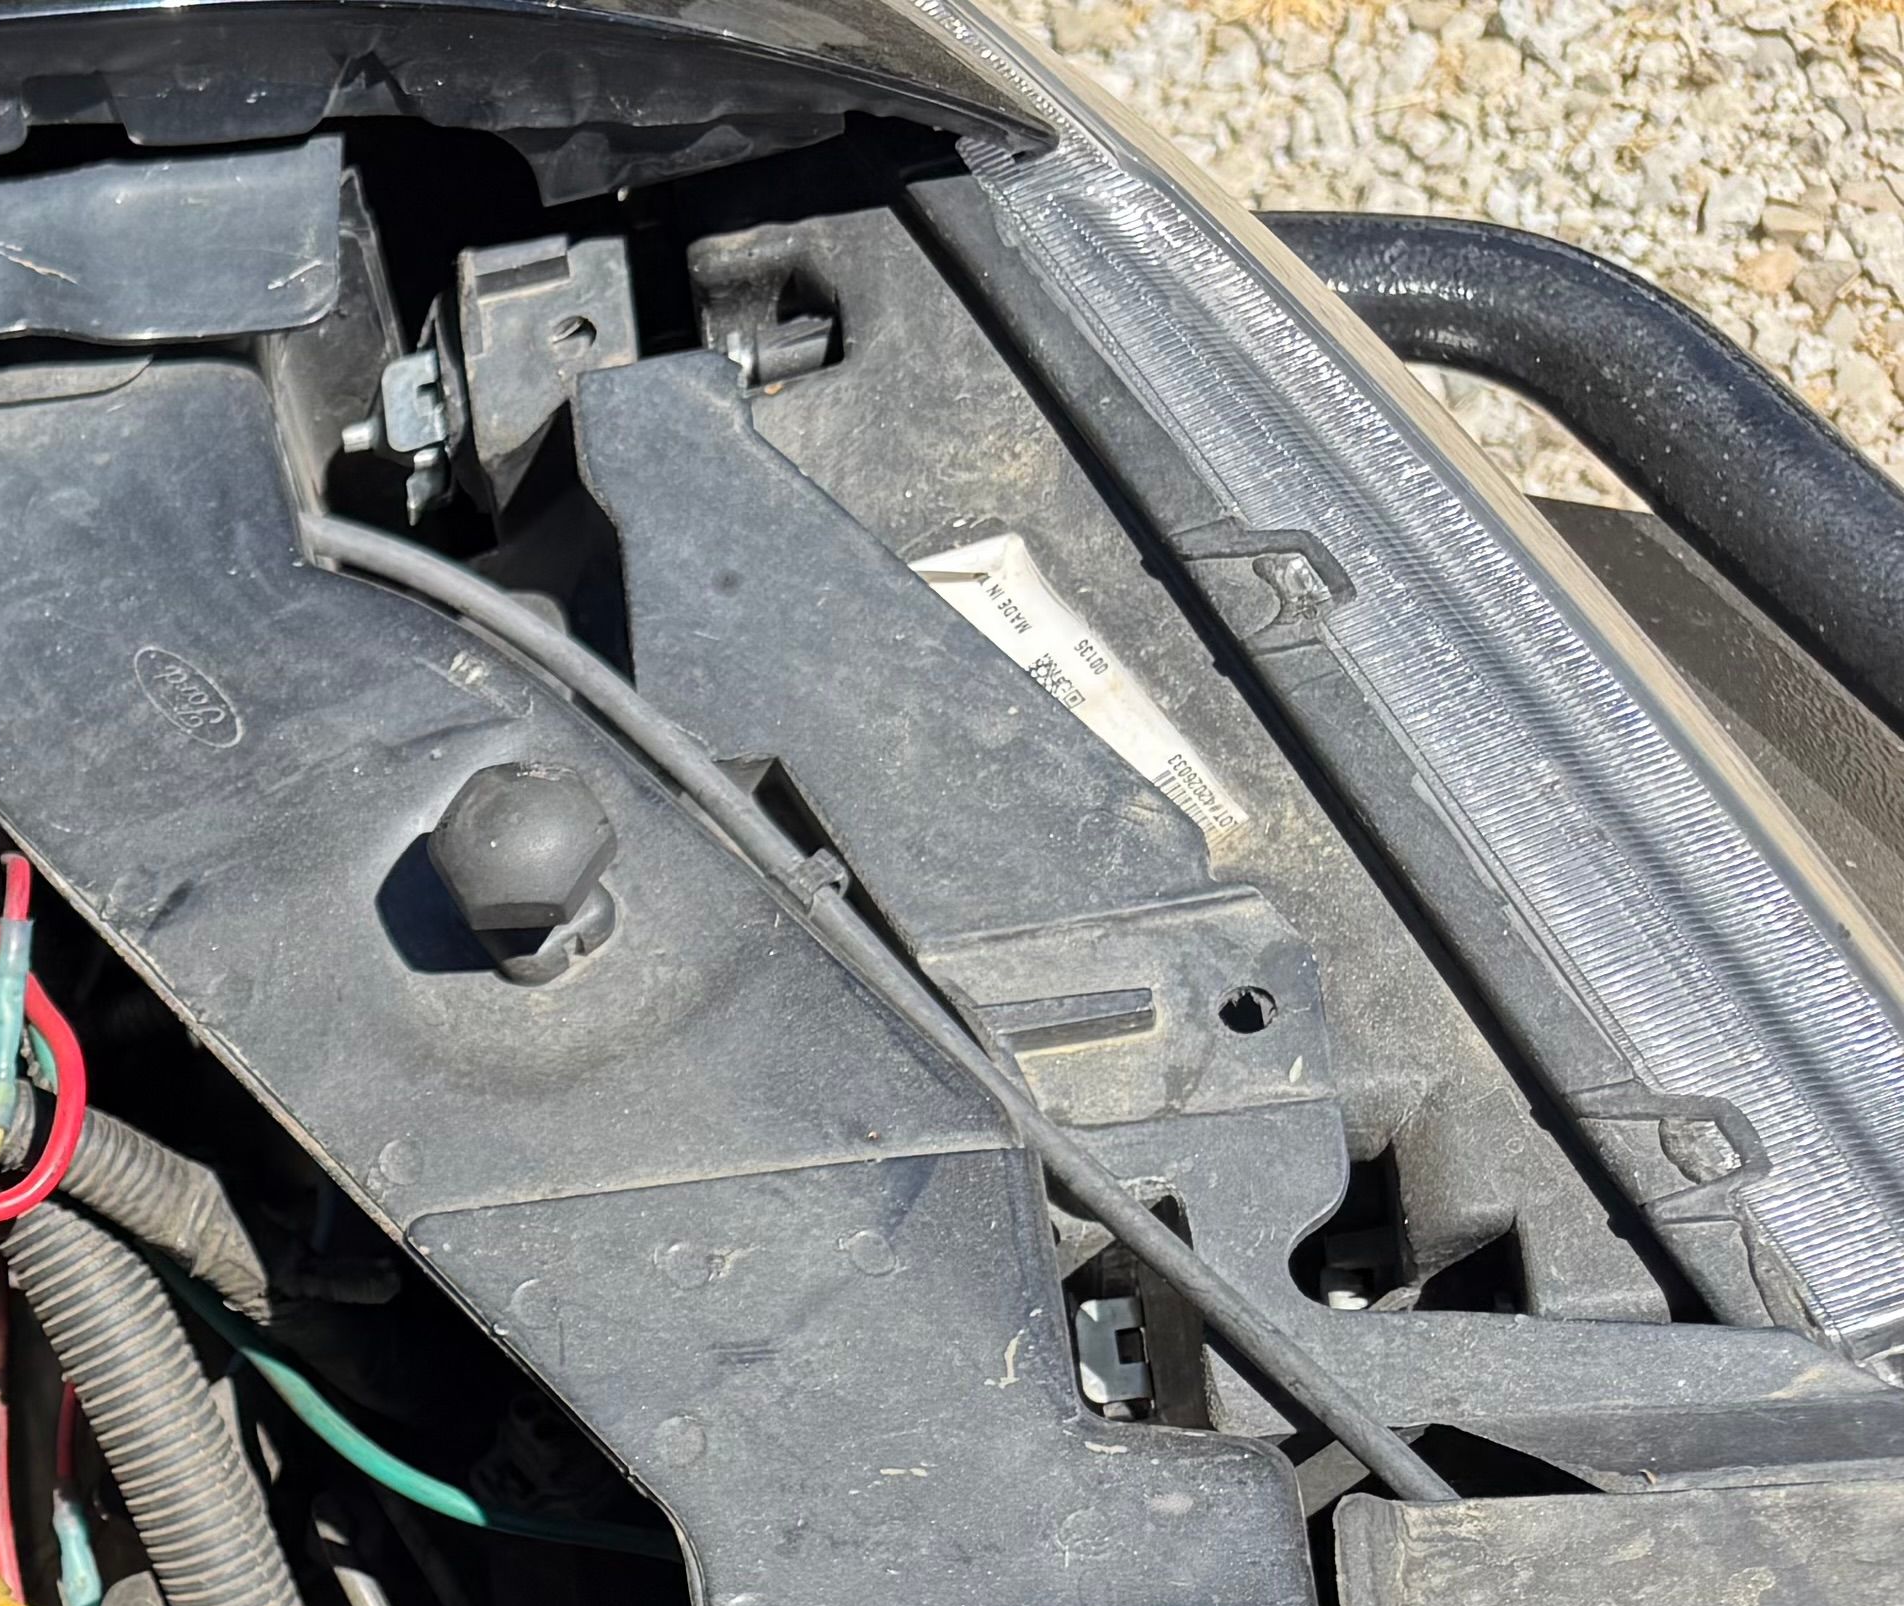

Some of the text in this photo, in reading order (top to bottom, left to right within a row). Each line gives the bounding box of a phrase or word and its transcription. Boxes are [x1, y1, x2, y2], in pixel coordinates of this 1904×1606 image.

[986, 584, 1032, 634] MADE IN
[1074, 639, 1109, 676] 00135
